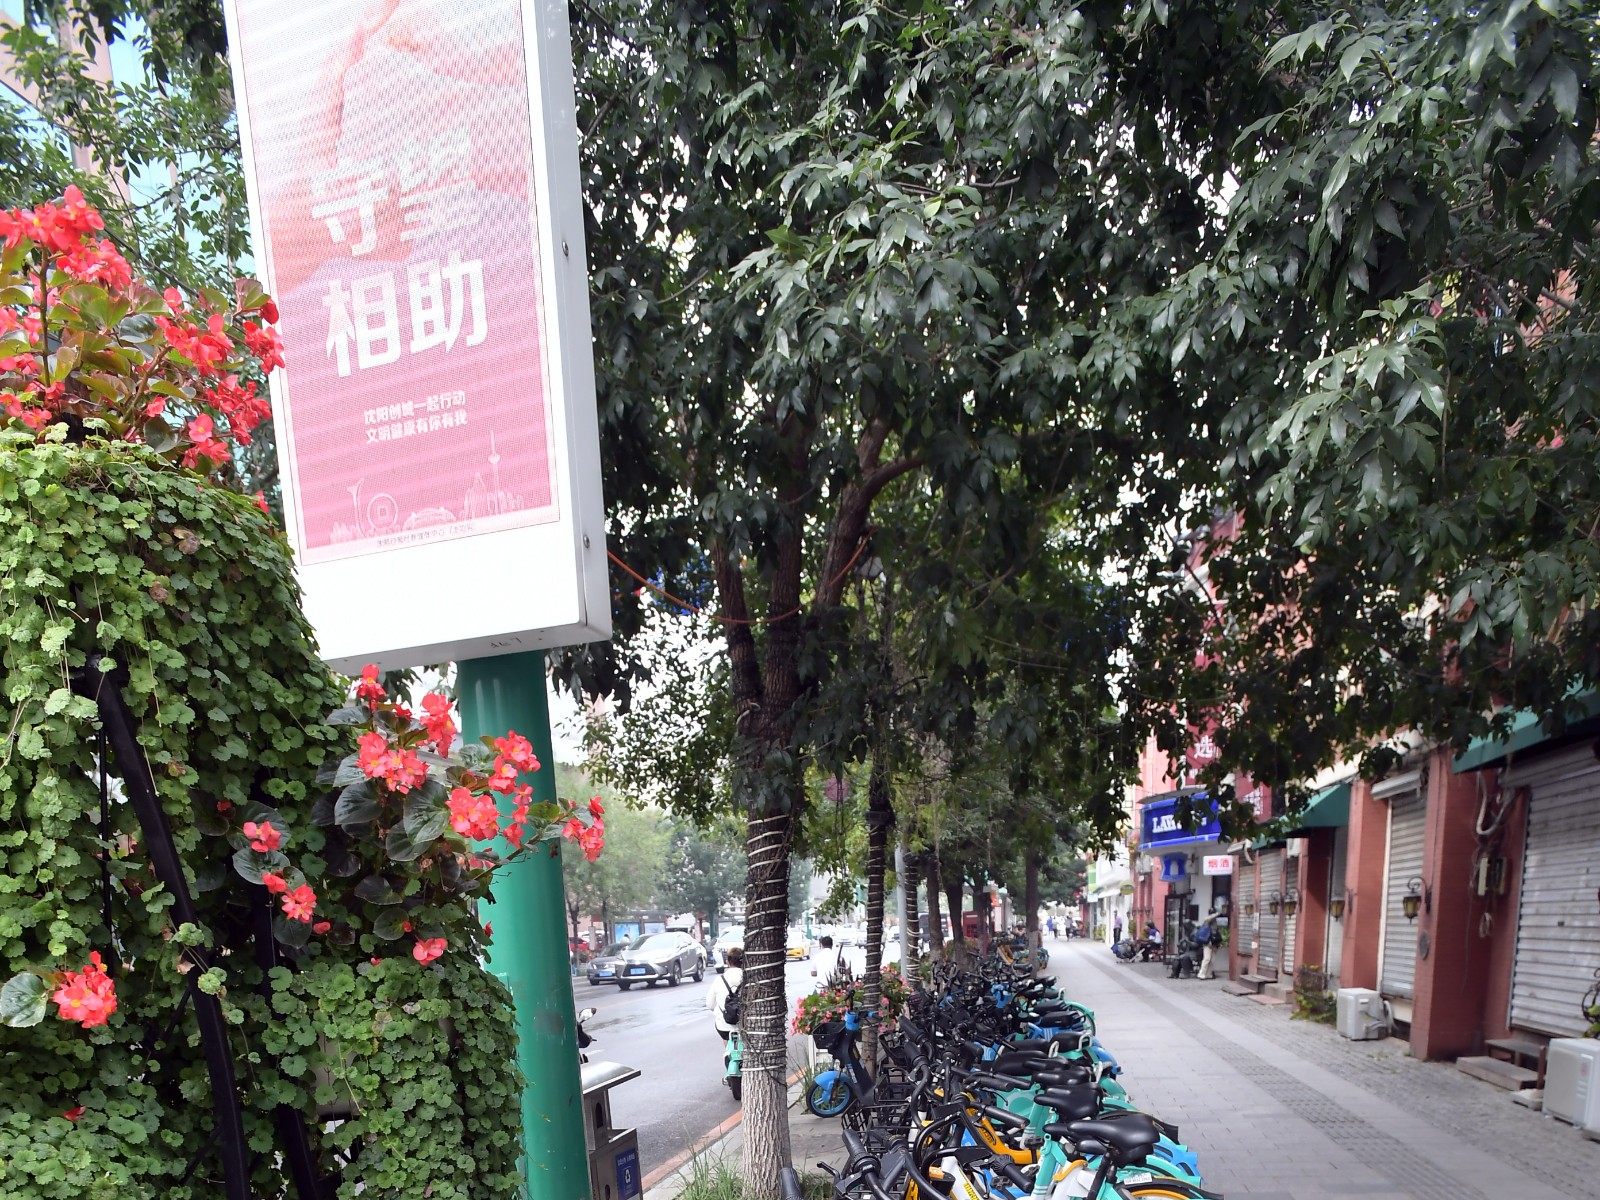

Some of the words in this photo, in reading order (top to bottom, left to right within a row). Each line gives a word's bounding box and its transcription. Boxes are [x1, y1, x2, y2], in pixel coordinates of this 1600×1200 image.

[312, 125, 482, 256] 守望
[322, 250, 489, 378] 相助
[366, 408, 468, 445] 文明健康有你有我
